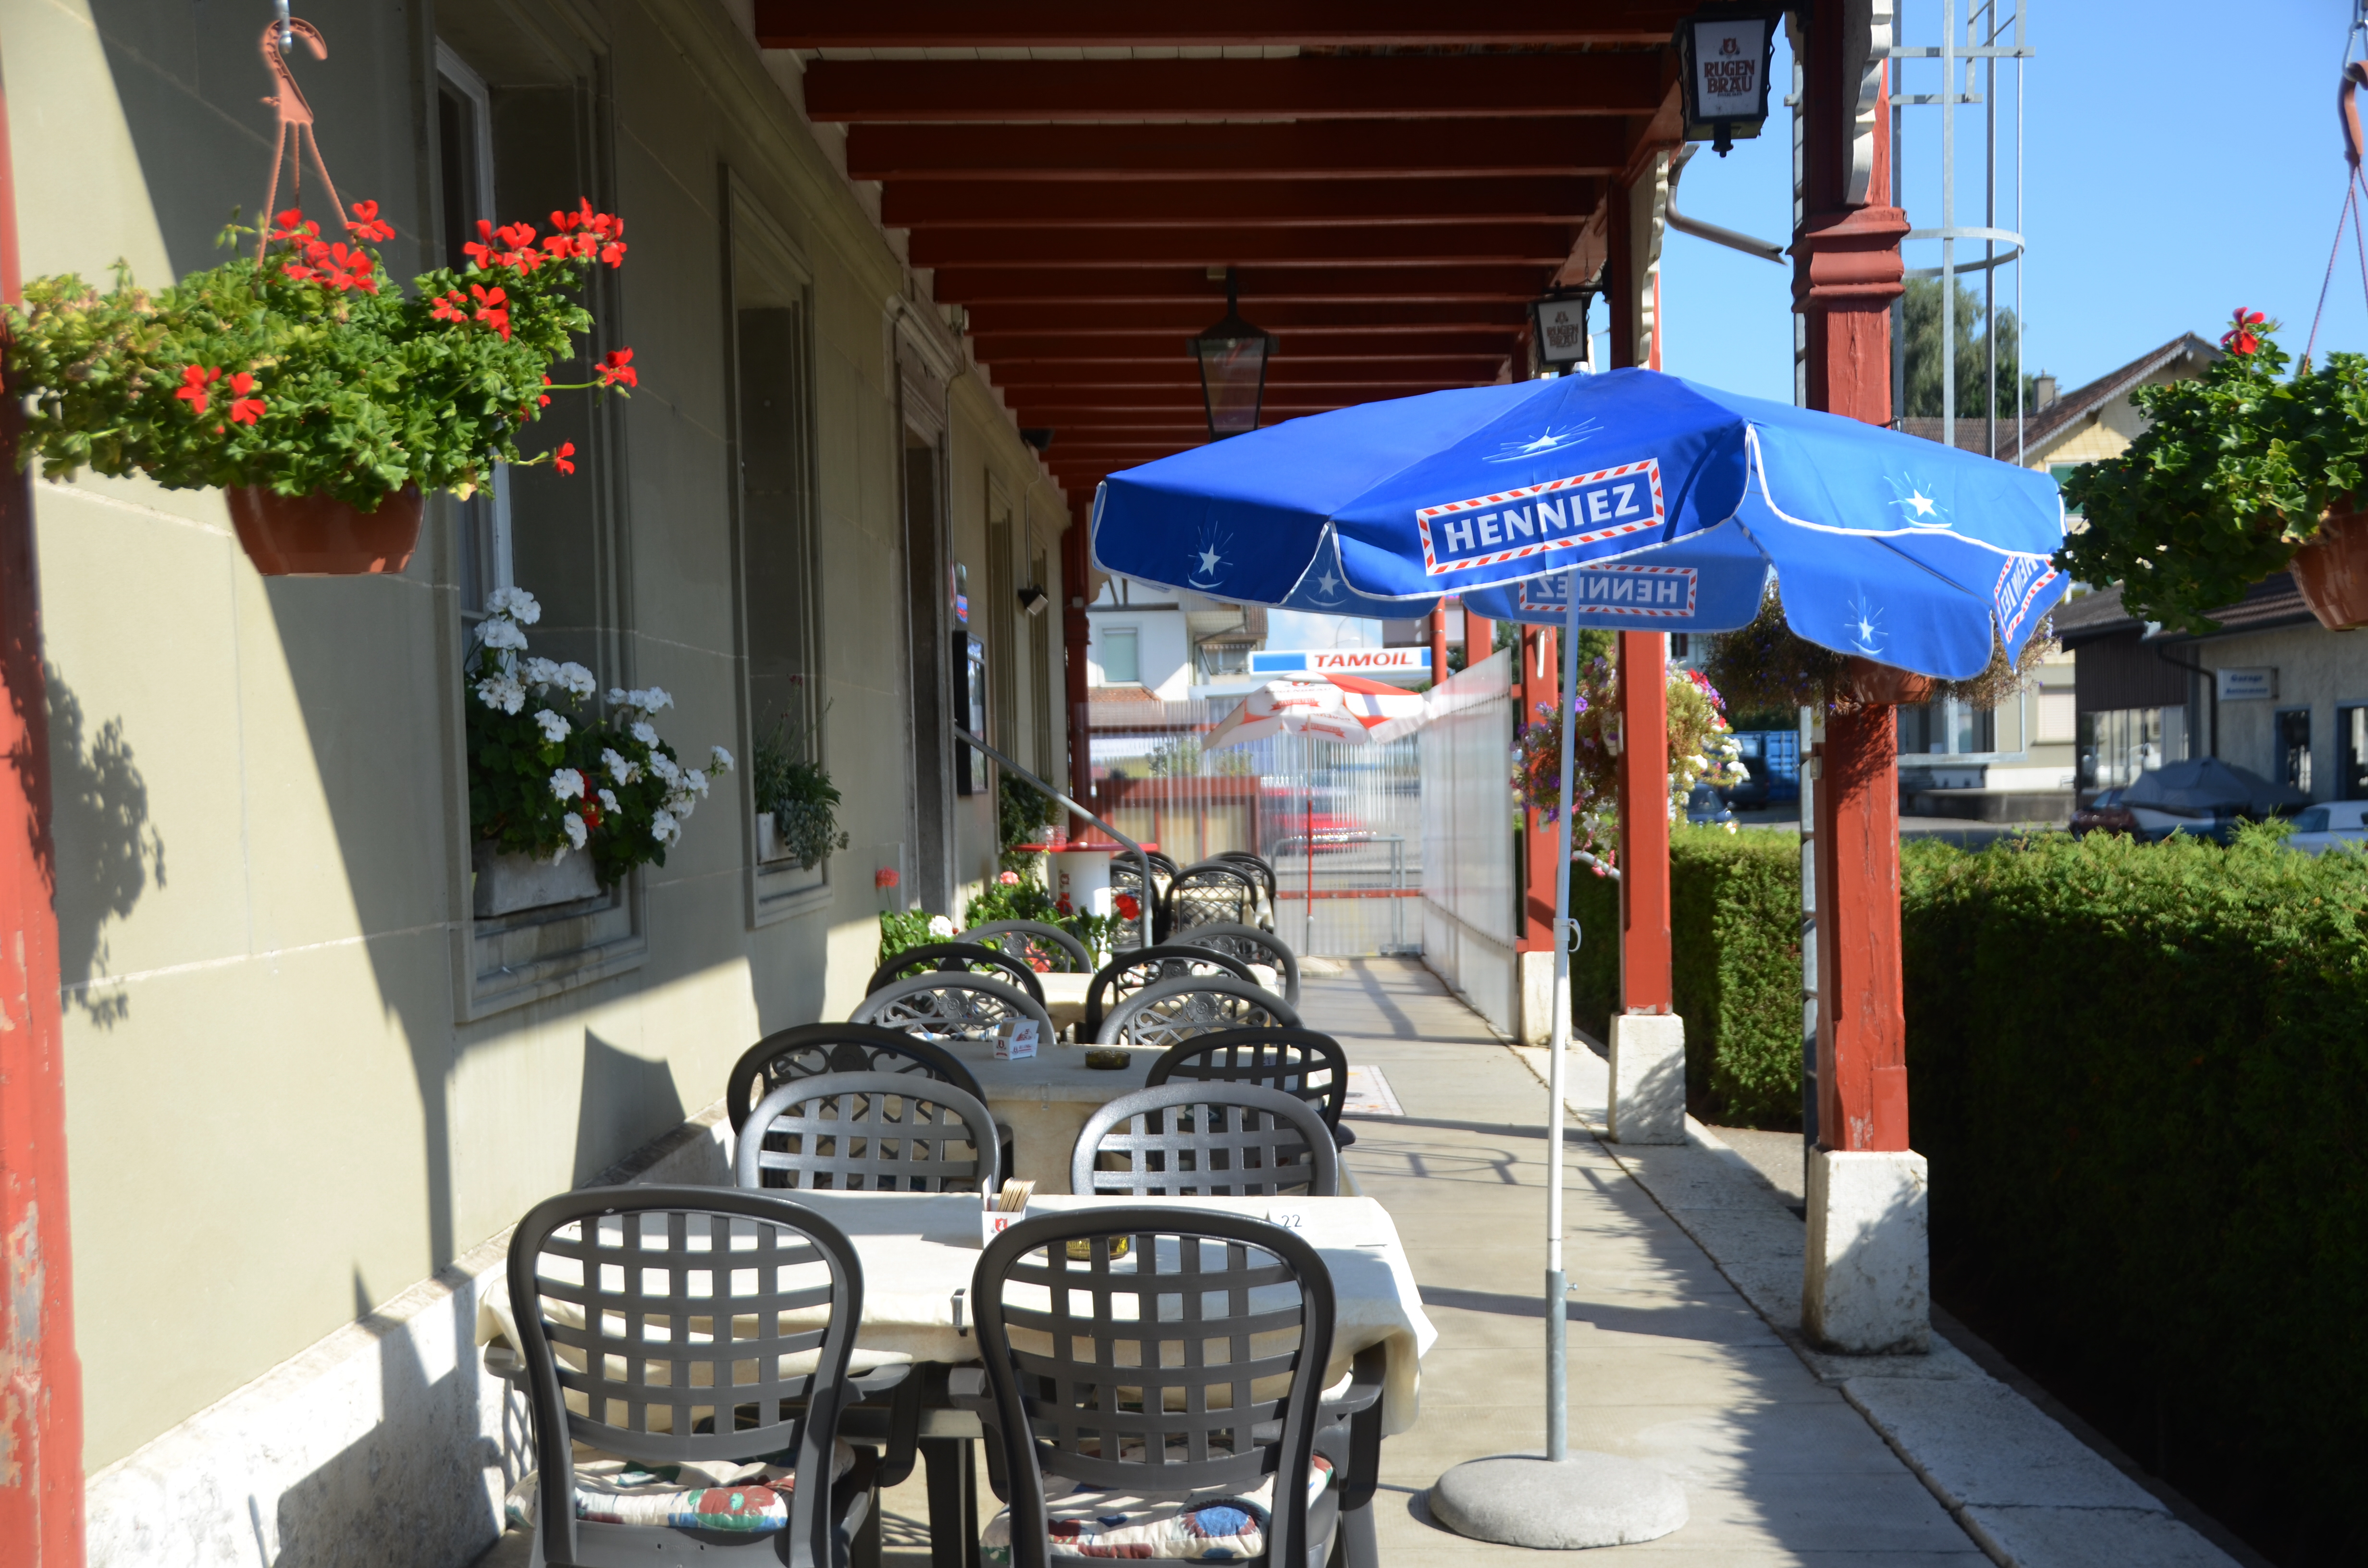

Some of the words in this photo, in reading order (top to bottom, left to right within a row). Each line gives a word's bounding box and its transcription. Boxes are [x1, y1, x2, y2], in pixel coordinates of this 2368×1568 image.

[1704, 60, 1755, 77] RUGEN
[1707, 75, 1752, 93] BRÄU
[1547, 324, 1579, 336] RUGEN
[1443, 483, 1640, 553] HENNIEZ
[1314, 652, 1413, 668] TAMOIL
[1282, 1214, 1302, 1229] 22
